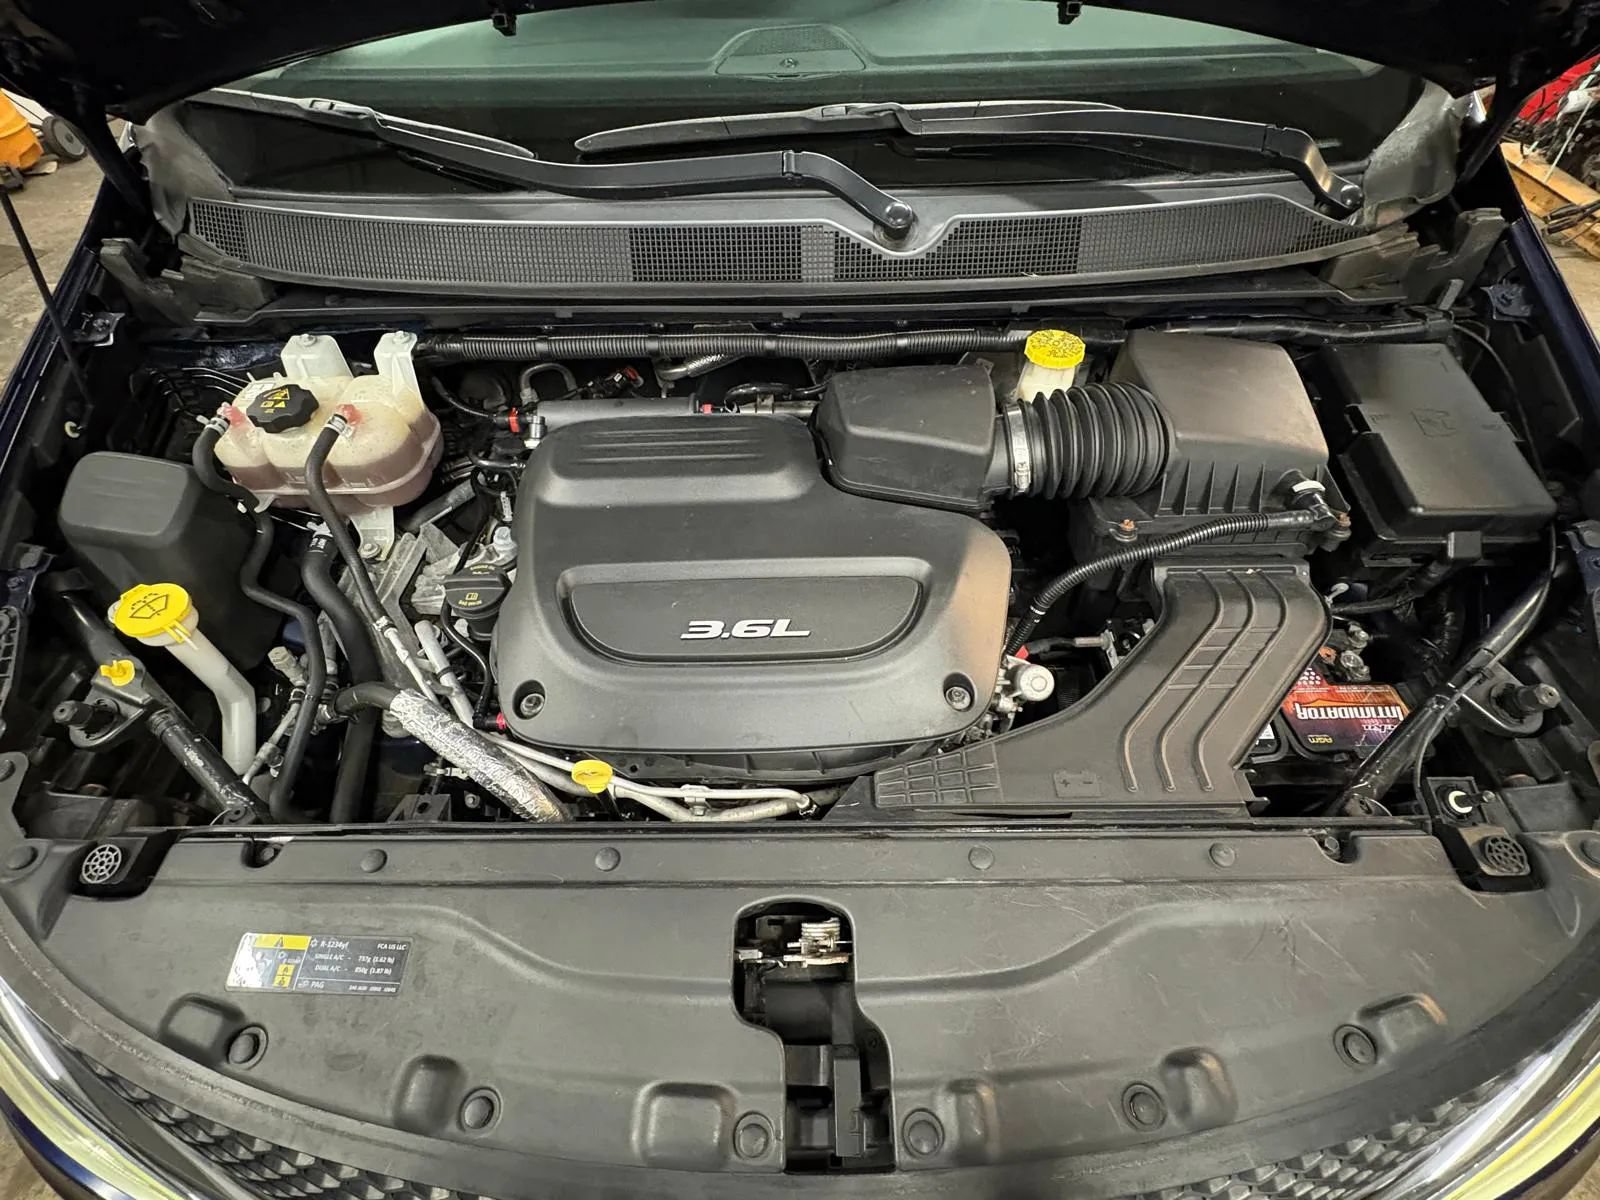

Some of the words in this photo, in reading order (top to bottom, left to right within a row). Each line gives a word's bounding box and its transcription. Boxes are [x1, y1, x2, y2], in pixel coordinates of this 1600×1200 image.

[680, 618, 811, 640] 3.6L
[1294, 702, 1404, 721] INTIMIDATOR
[310, 981, 325, 989] PAG
